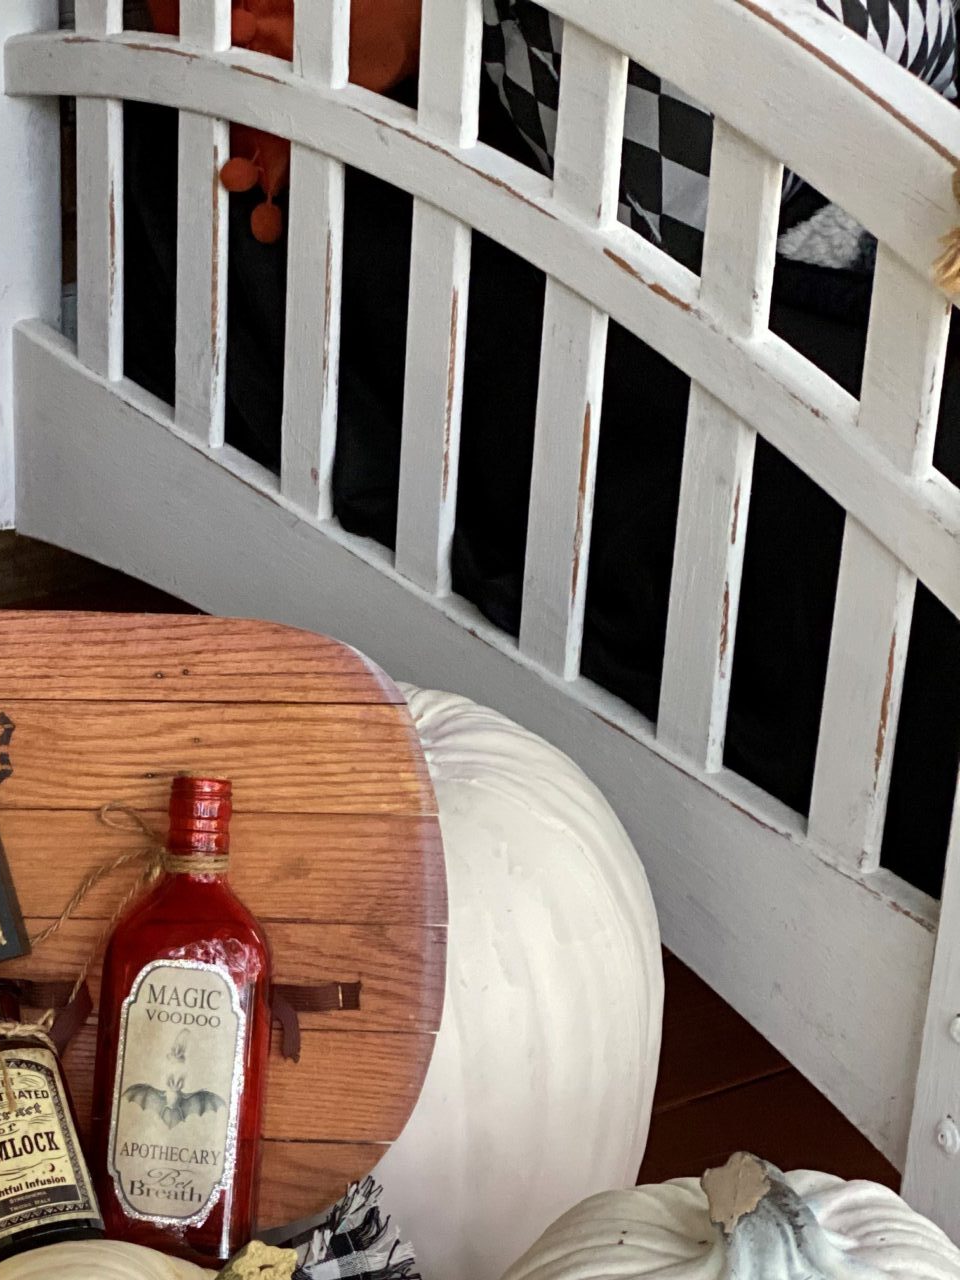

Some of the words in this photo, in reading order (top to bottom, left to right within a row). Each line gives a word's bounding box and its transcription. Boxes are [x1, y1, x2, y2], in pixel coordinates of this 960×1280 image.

[146, 983, 222, 1011] MAGIC
[145, 1008, 222, 1028] VOODOO
[120, 1141, 222, 1166] APOTHECARY
[25, 1175, 67, 1190] Infusion
[129, 1179, 202, 1203] Breath
